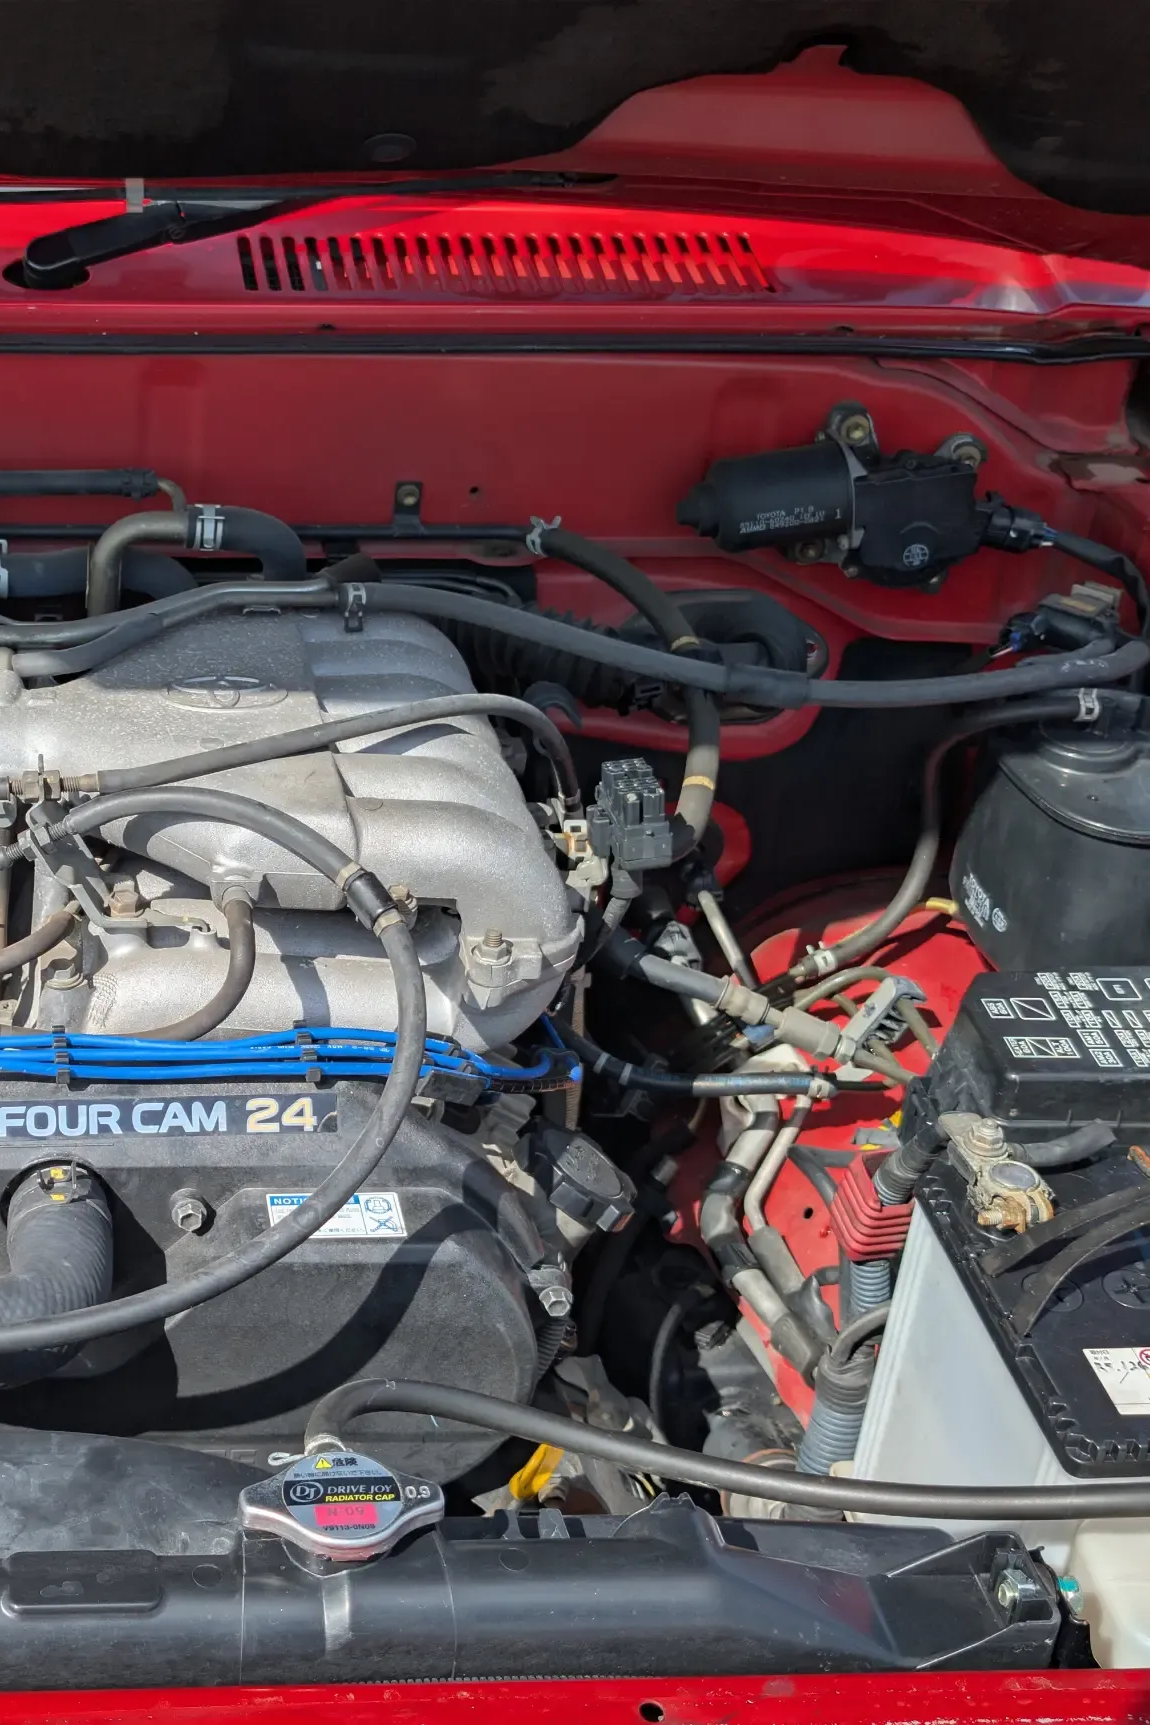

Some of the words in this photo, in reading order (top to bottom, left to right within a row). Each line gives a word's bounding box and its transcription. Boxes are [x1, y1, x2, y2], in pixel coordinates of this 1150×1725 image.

[131, 1100, 227, 1134] CAM
[246, 1097, 318, 1133] 24
[332, 1457, 358, 1467] 危険
[327, 1484, 366, 1494] DRIVE
[370, 1484, 392, 1493] JOY
[405, 1486, 431, 1499] 0.9
[325, 1494, 373, 1502] RADIATOR
[375, 1493, 395, 1501] CAP
